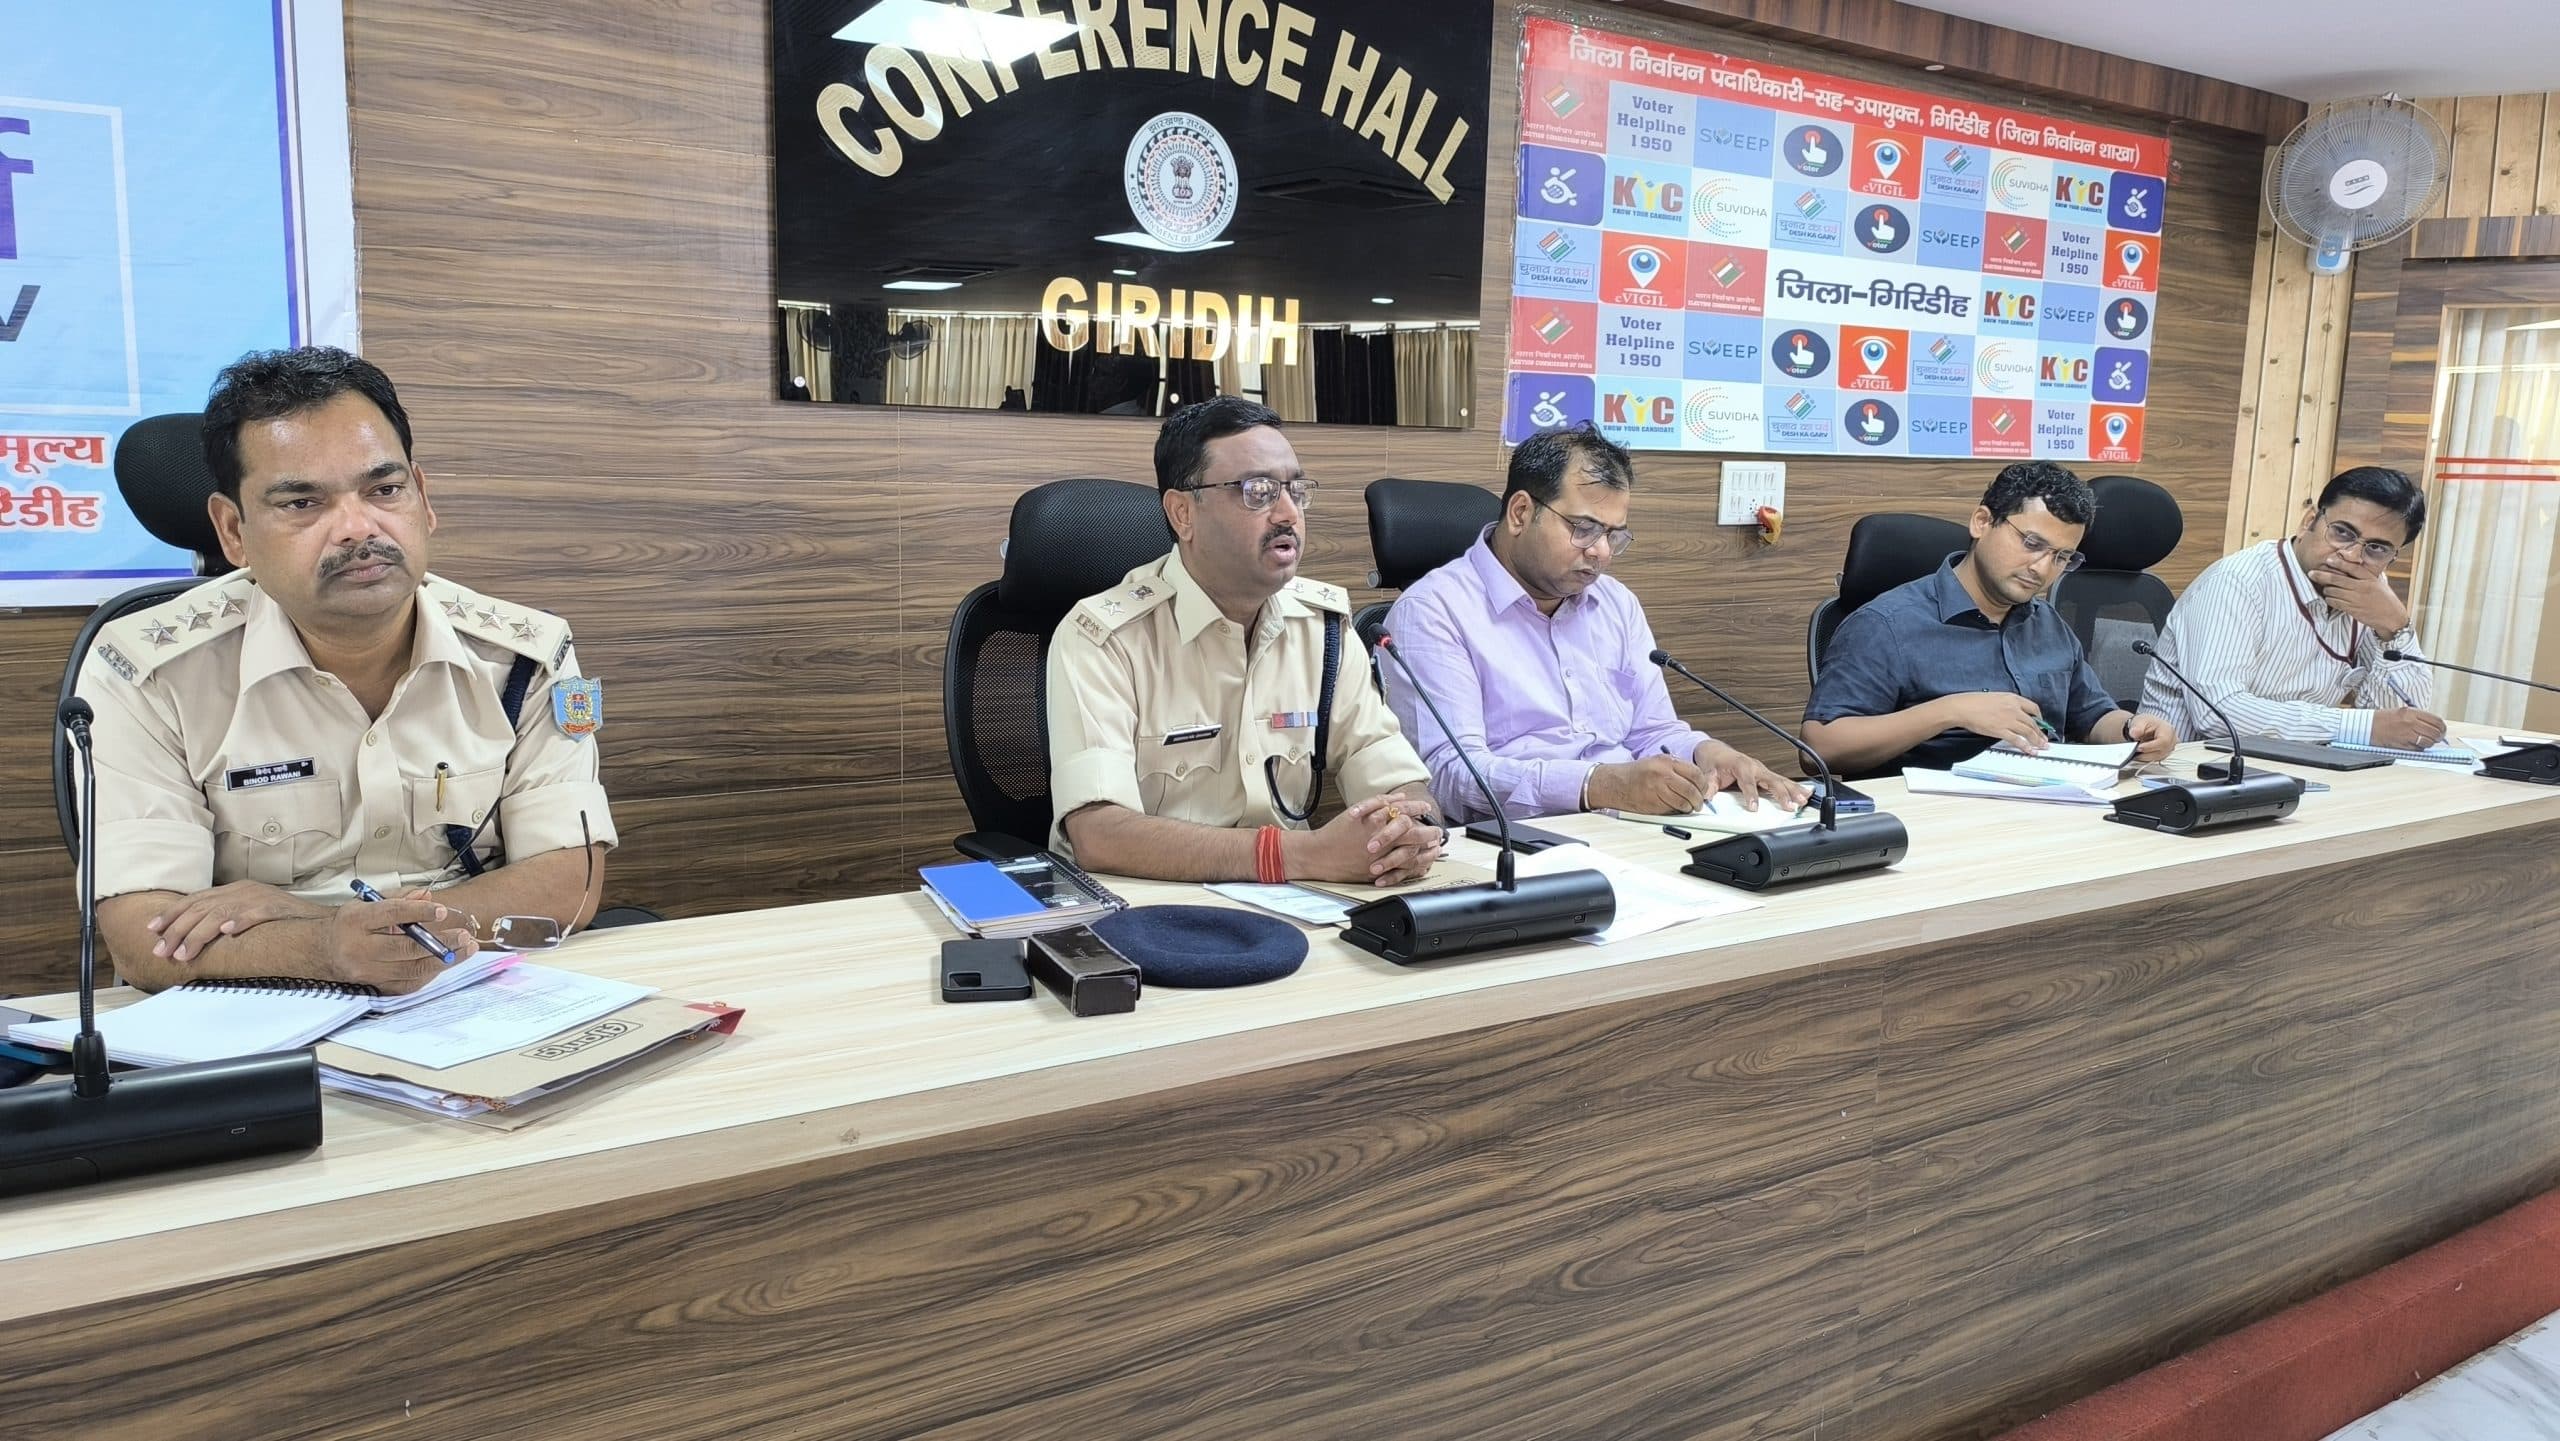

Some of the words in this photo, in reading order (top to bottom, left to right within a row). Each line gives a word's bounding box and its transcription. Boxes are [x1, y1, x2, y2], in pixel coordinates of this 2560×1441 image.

[1568, 34, 1624, 69] जिला
[1629, 45, 1706, 84] निर्वाचन
[1930, 105, 1992, 138] गिरिडीह
[1995, 117, 2040, 147] (जिला
[2043, 126, 2096, 155] निर्वाचन
[2099, 142, 2140, 168] शाखा)
[1632, 95, 1674, 115] Voter
[1320, 30, 1469, 205] HALL
[1617, 113, 1686, 136] Helpline
[1631, 134, 1672, 152] 1950
[1700, 128, 1769, 152] SWEEP
[1612, 173, 1683, 213] KYC
[2009, 179, 2049, 192] SUVIDHA
[2056, 174, 2104, 206] KYC
[1716, 202, 1768, 217] SUVIDHA
[1922, 230, 1980, 249] SWEEP
[2062, 231, 2091, 245] Voter
[2052, 245, 2099, 262] Helpline
[2061, 263, 2089, 276] 1950
[1531, 274, 1552, 282] DESH
[1565, 277, 1588, 286] GARV
[1776, 269, 1972, 318] जिला-गिरिडीह
[1984, 290, 2035, 320] KYC
[1041, 277, 1299, 366] GIRIDIH
[1620, 316, 1662, 331] Voter
[2044, 307, 2095, 323] SWEEP
[1606, 333, 1675, 351] Helpline
[1689, 341, 1758, 359] SWEEP
[1620, 353, 1661, 368] 1950
[1995, 363, 2033, 373] SUVIDHA
[2041, 356, 2088, 383] KYC
[1604, 393, 1674, 425] KYC
[1708, 411, 1760, 422] SUVIDHA
[2048, 410, 2075, 420] Voter
[1912, 420, 1968, 434] SWEEP
[2038, 424, 2083, 436] Helpline
[2048, 439, 2075, 449] 1950
[243, 776, 269, 786] BINOD
[271, 771, 301, 782] RAWANI
